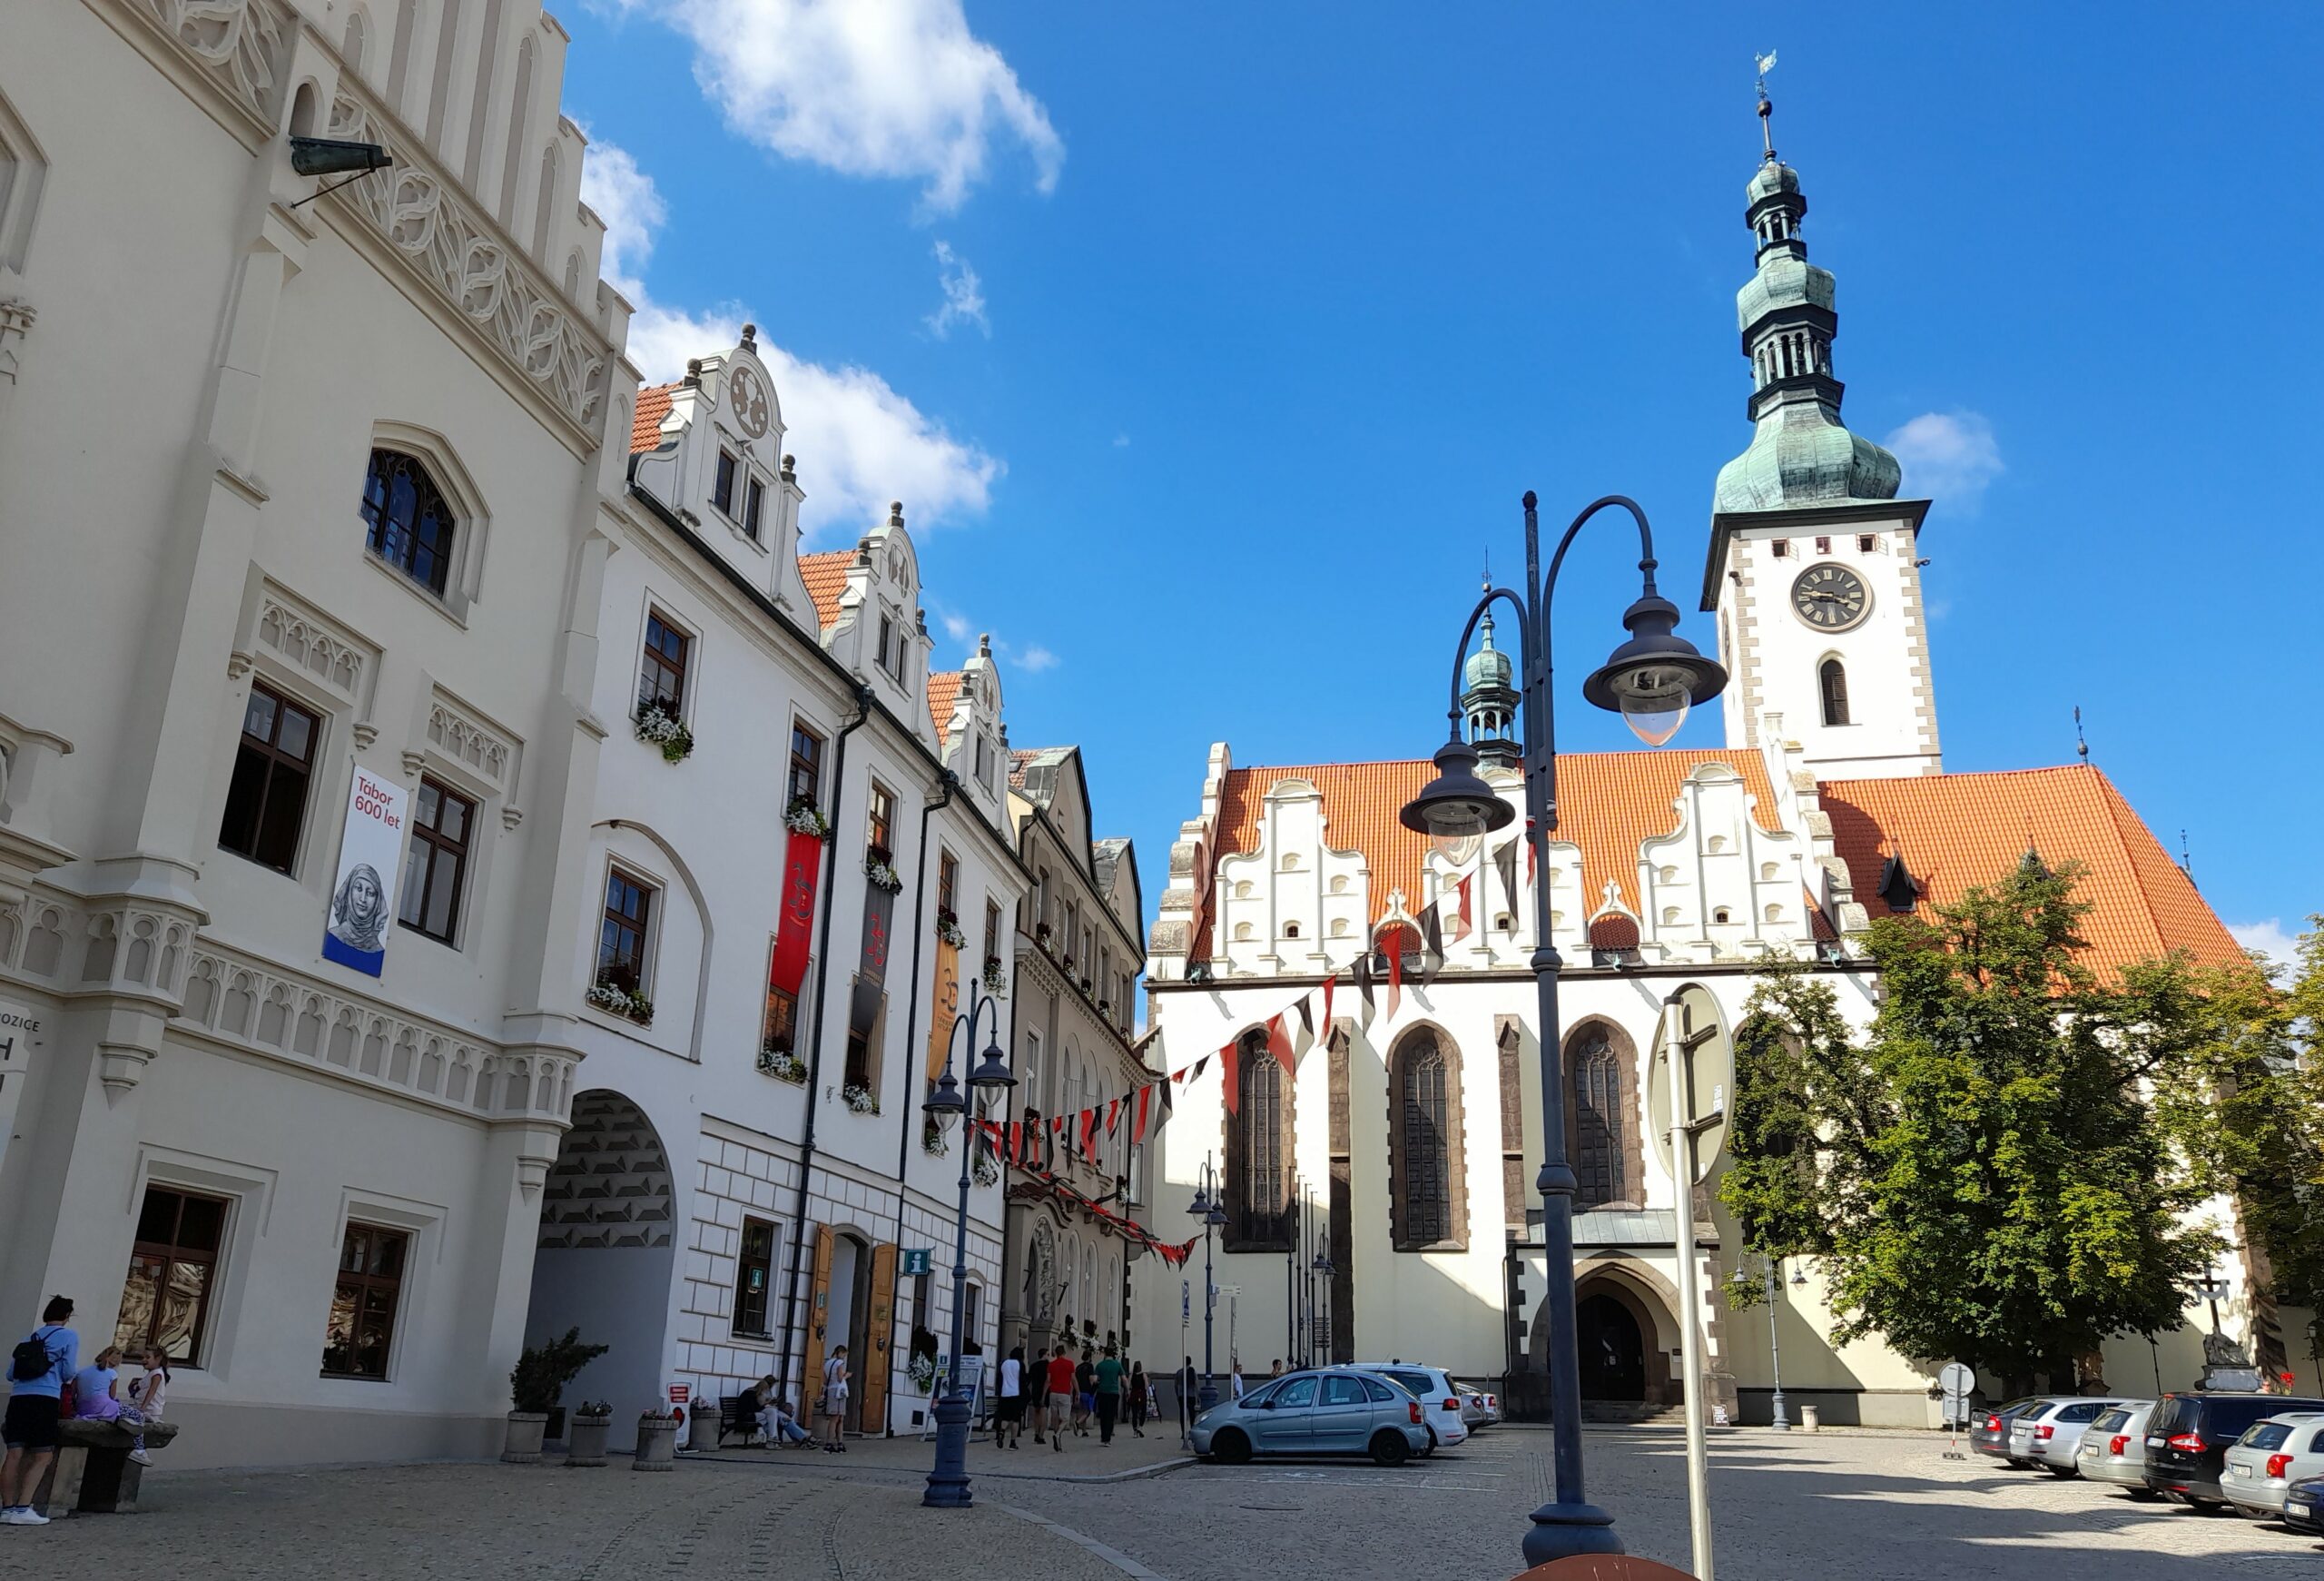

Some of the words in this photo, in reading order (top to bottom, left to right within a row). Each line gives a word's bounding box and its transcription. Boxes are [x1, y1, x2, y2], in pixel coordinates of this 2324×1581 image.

[359, 776, 394, 805] Tábor
[355, 795, 382, 819] 600
[384, 808, 400, 829] let
[0, 1013, 40, 1033] OZICE
